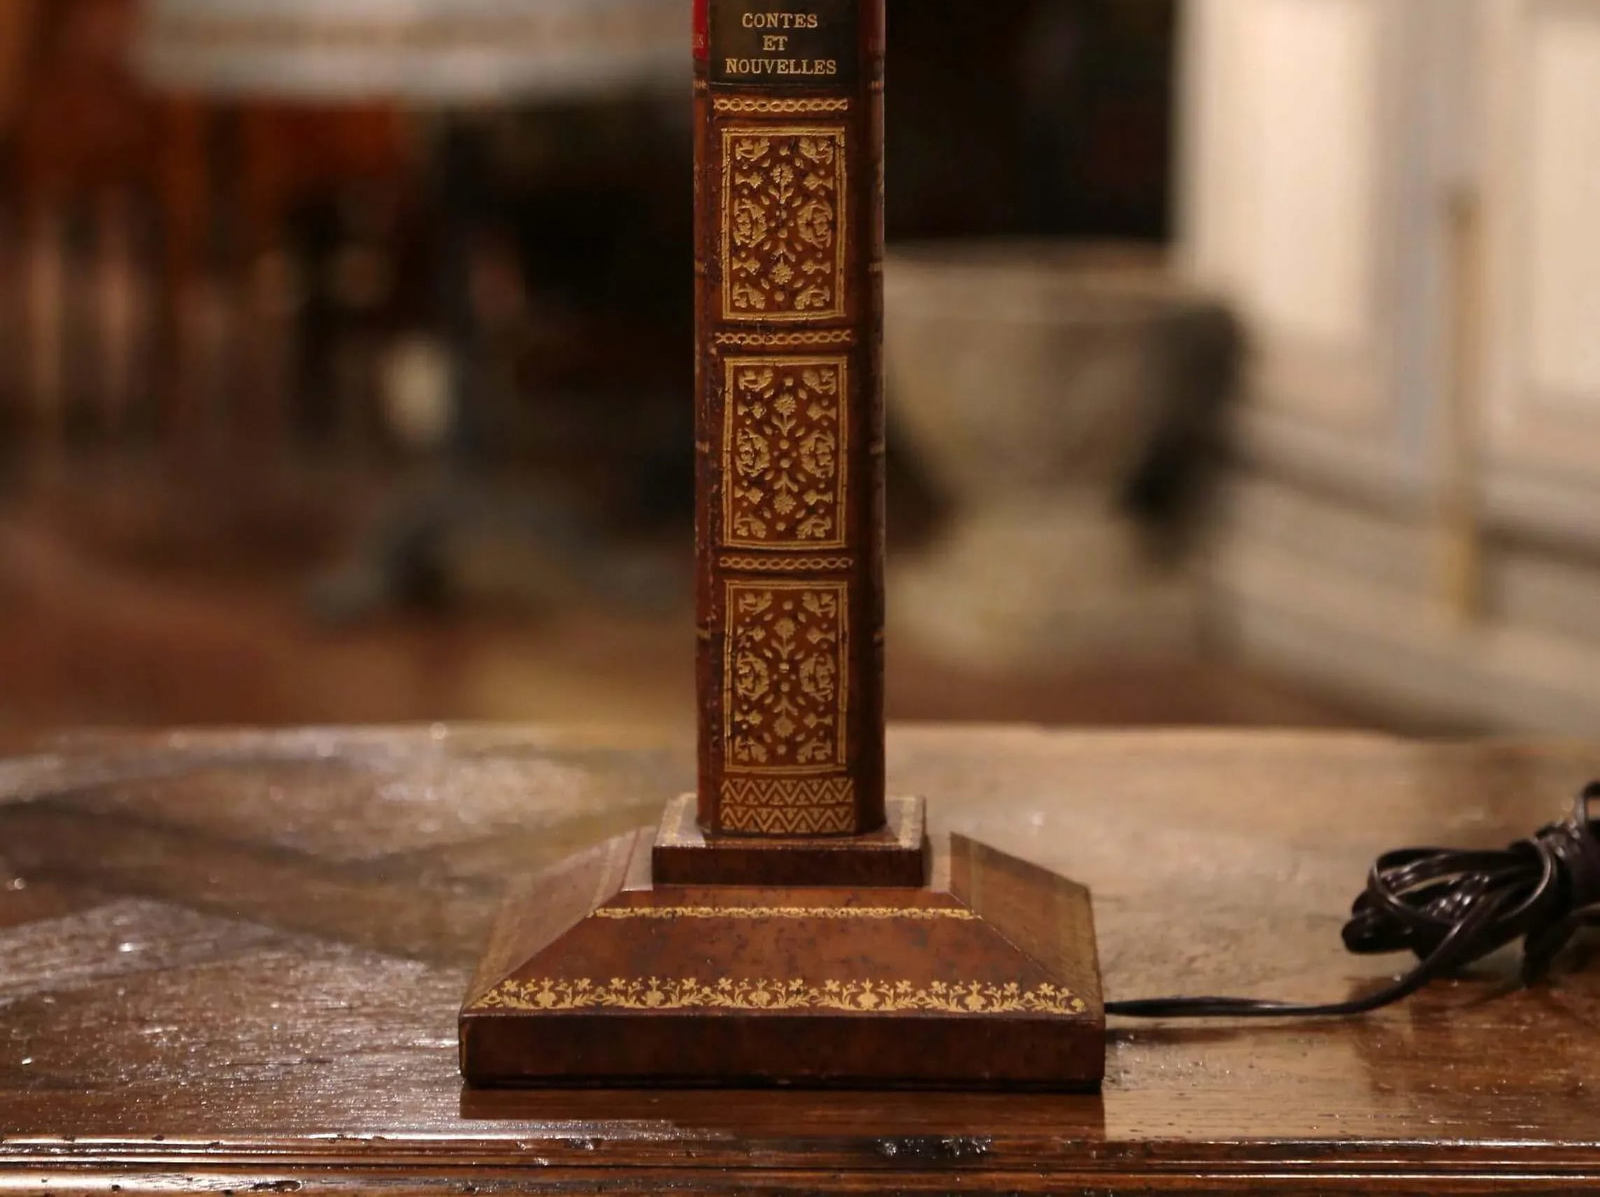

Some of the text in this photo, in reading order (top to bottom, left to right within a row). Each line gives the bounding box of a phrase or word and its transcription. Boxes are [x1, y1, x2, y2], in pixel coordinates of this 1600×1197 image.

[742, 13, 818, 29] CONTES
[762, 35, 788, 51] ET
[725, 59, 837, 75] NOUVELLES
